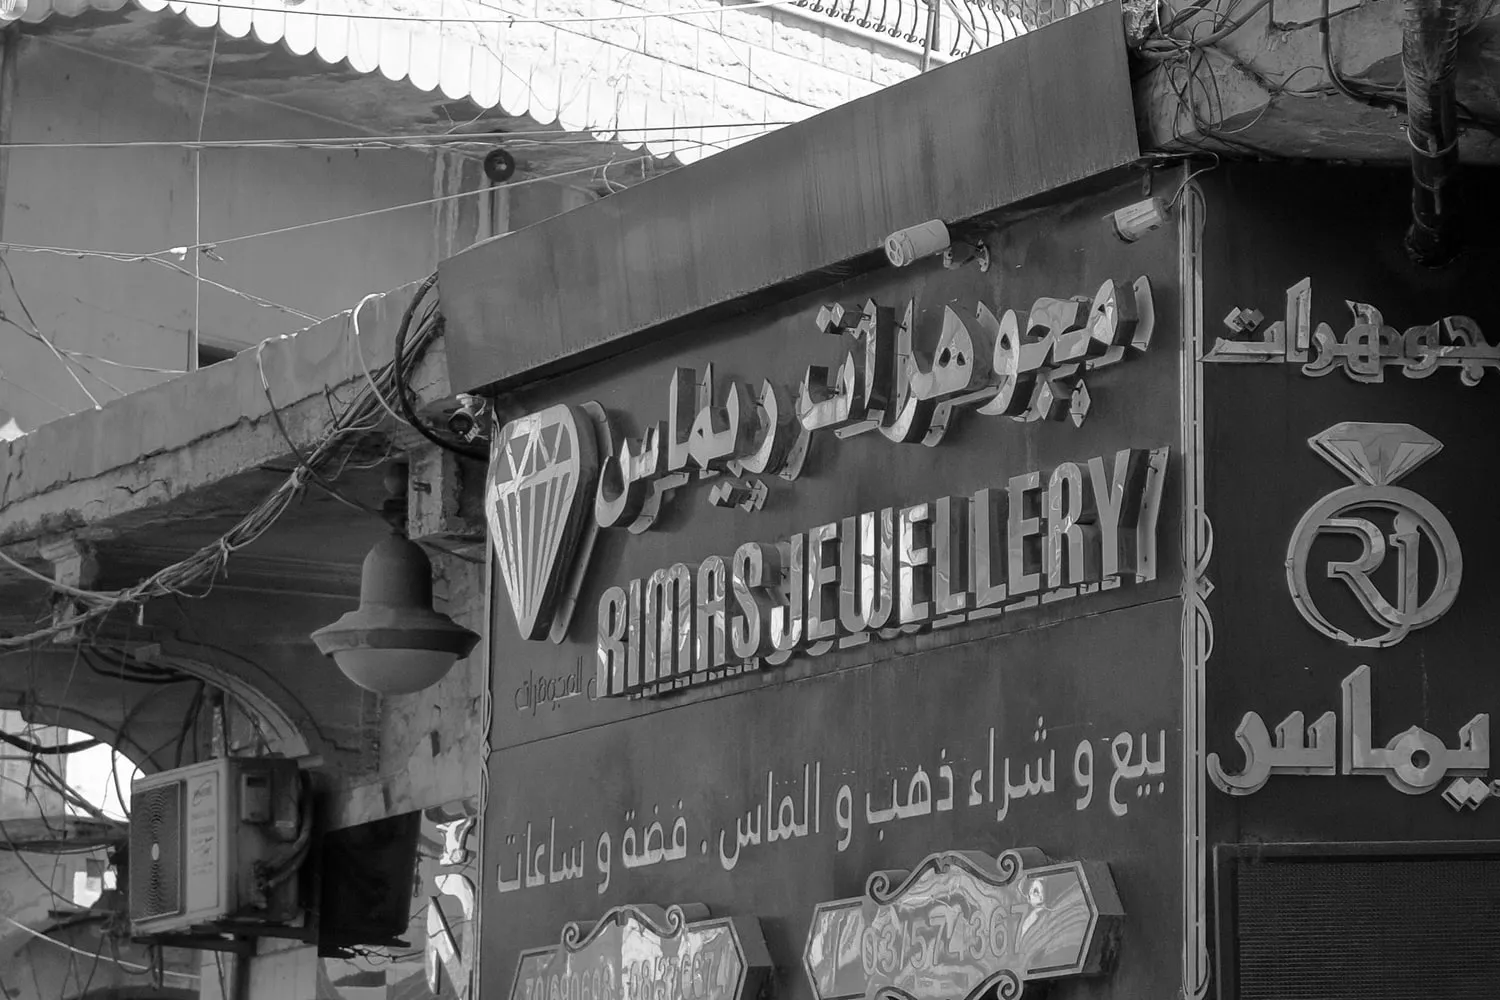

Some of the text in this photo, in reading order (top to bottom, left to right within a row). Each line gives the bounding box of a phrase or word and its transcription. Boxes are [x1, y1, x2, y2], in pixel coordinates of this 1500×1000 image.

[800, 276, 1150, 446] مجوهرات
[595, 363, 800, 534] ريماس
[597, 447, 1166, 699] RIMAS JEWELLERY
[866, 746, 954, 841] ذهب
[968, 715, 1057, 822] شراء
[1074, 737, 1094, 809] و
[1109, 728, 1167, 817] بيع
[498, 816, 585, 893] ساعات
[621, 799, 689, 870] فضة
[719, 761, 822, 871] الماس
[834, 788, 853, 851] و
[596, 834, 612, 894] و
[860, 902, 1031, 976] 03/574367
